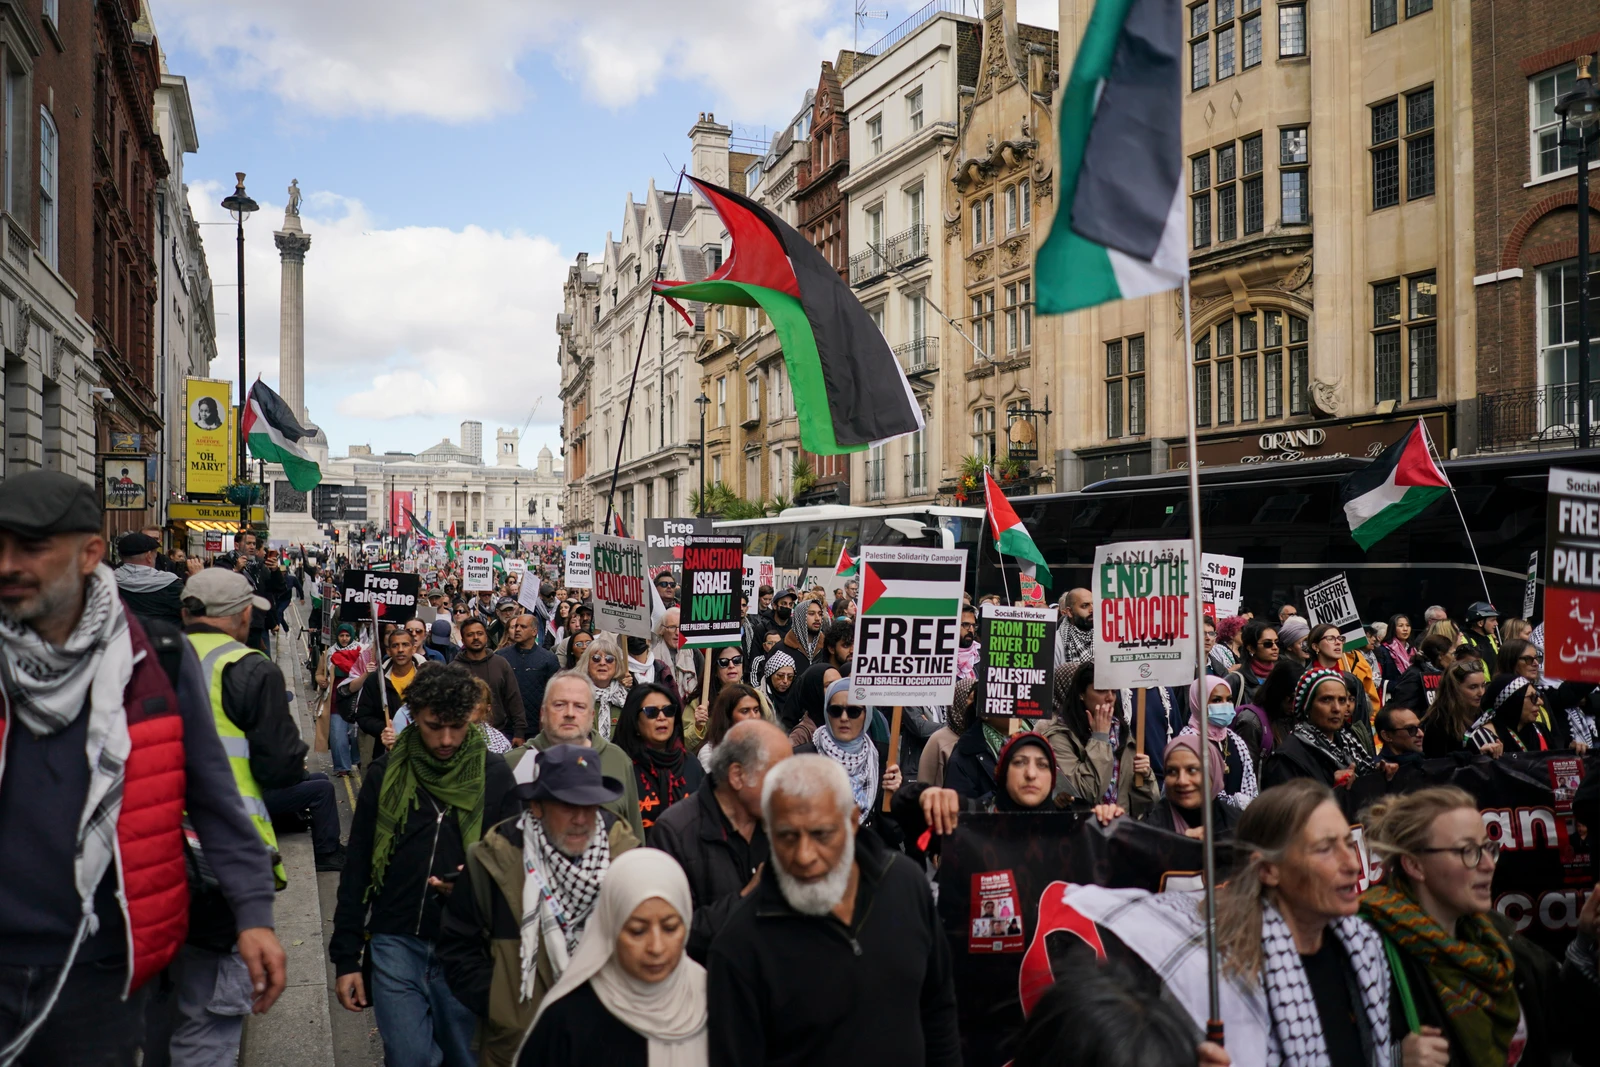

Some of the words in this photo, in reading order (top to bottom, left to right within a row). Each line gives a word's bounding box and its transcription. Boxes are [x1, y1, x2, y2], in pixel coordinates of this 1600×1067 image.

[1258, 428, 1327, 453] GRAND
[1558, 499, 1600, 536] FRE
[663, 521, 694, 534] Free
[648, 534, 684, 548] Pales
[468, 556, 488, 564] Stop
[570, 551, 590, 560] Stop
[594, 546, 622, 575] END
[623, 551, 644, 579] THE
[684, 548, 742, 570] SANCTION
[865, 552, 896, 560] Palestine
[897, 552, 930, 562] Solidarity
[930, 554, 963, 563] Campaign
[568, 561, 592, 570] Arming
[1207, 562, 1236, 578] Stop
[364, 574, 399, 590] Free
[692, 572, 732, 594] ISRAEL
[1100, 561, 1153, 600] END
[1160, 559, 1190, 598] THE
[344, 588, 414, 606] Palestine
[596, 570, 646, 608] GENOCIDE
[1307, 580, 1348, 610] CEASEFIRE
[692, 594, 732, 621] NOW!
[994, 609, 1023, 619] Socialist
[1024, 612, 1046, 620] Worker
[1315, 596, 1351, 625] NOW!
[680, 623, 690, 631] FREE
[690, 622, 710, 630] PALESTINE
[1101, 594, 1190, 642] GENOCIDE
[858, 618, 957, 656] FREE
[990, 620, 1024, 636] FROM
[1026, 622, 1046, 638] THE
[990, 636, 1022, 652] RIVER
[1026, 638, 1040, 653] TO
[856, 656, 954, 674] PALESTINE
[988, 652, 1010, 668] THE
[1013, 654, 1034, 668] SEA
[1134, 652, 1180, 660] PALESTINE
[856, 676, 873, 686] END
[874, 676, 904, 686] ISRAELI
[905, 676, 952, 686] OCCUPATION
[987, 666, 1046, 684] PALESTINE
[986, 682, 1014, 698] WILL
[1016, 684, 1032, 700] BE
[985, 698, 1014, 714] FREE
[1496, 890, 1593, 932] ca
